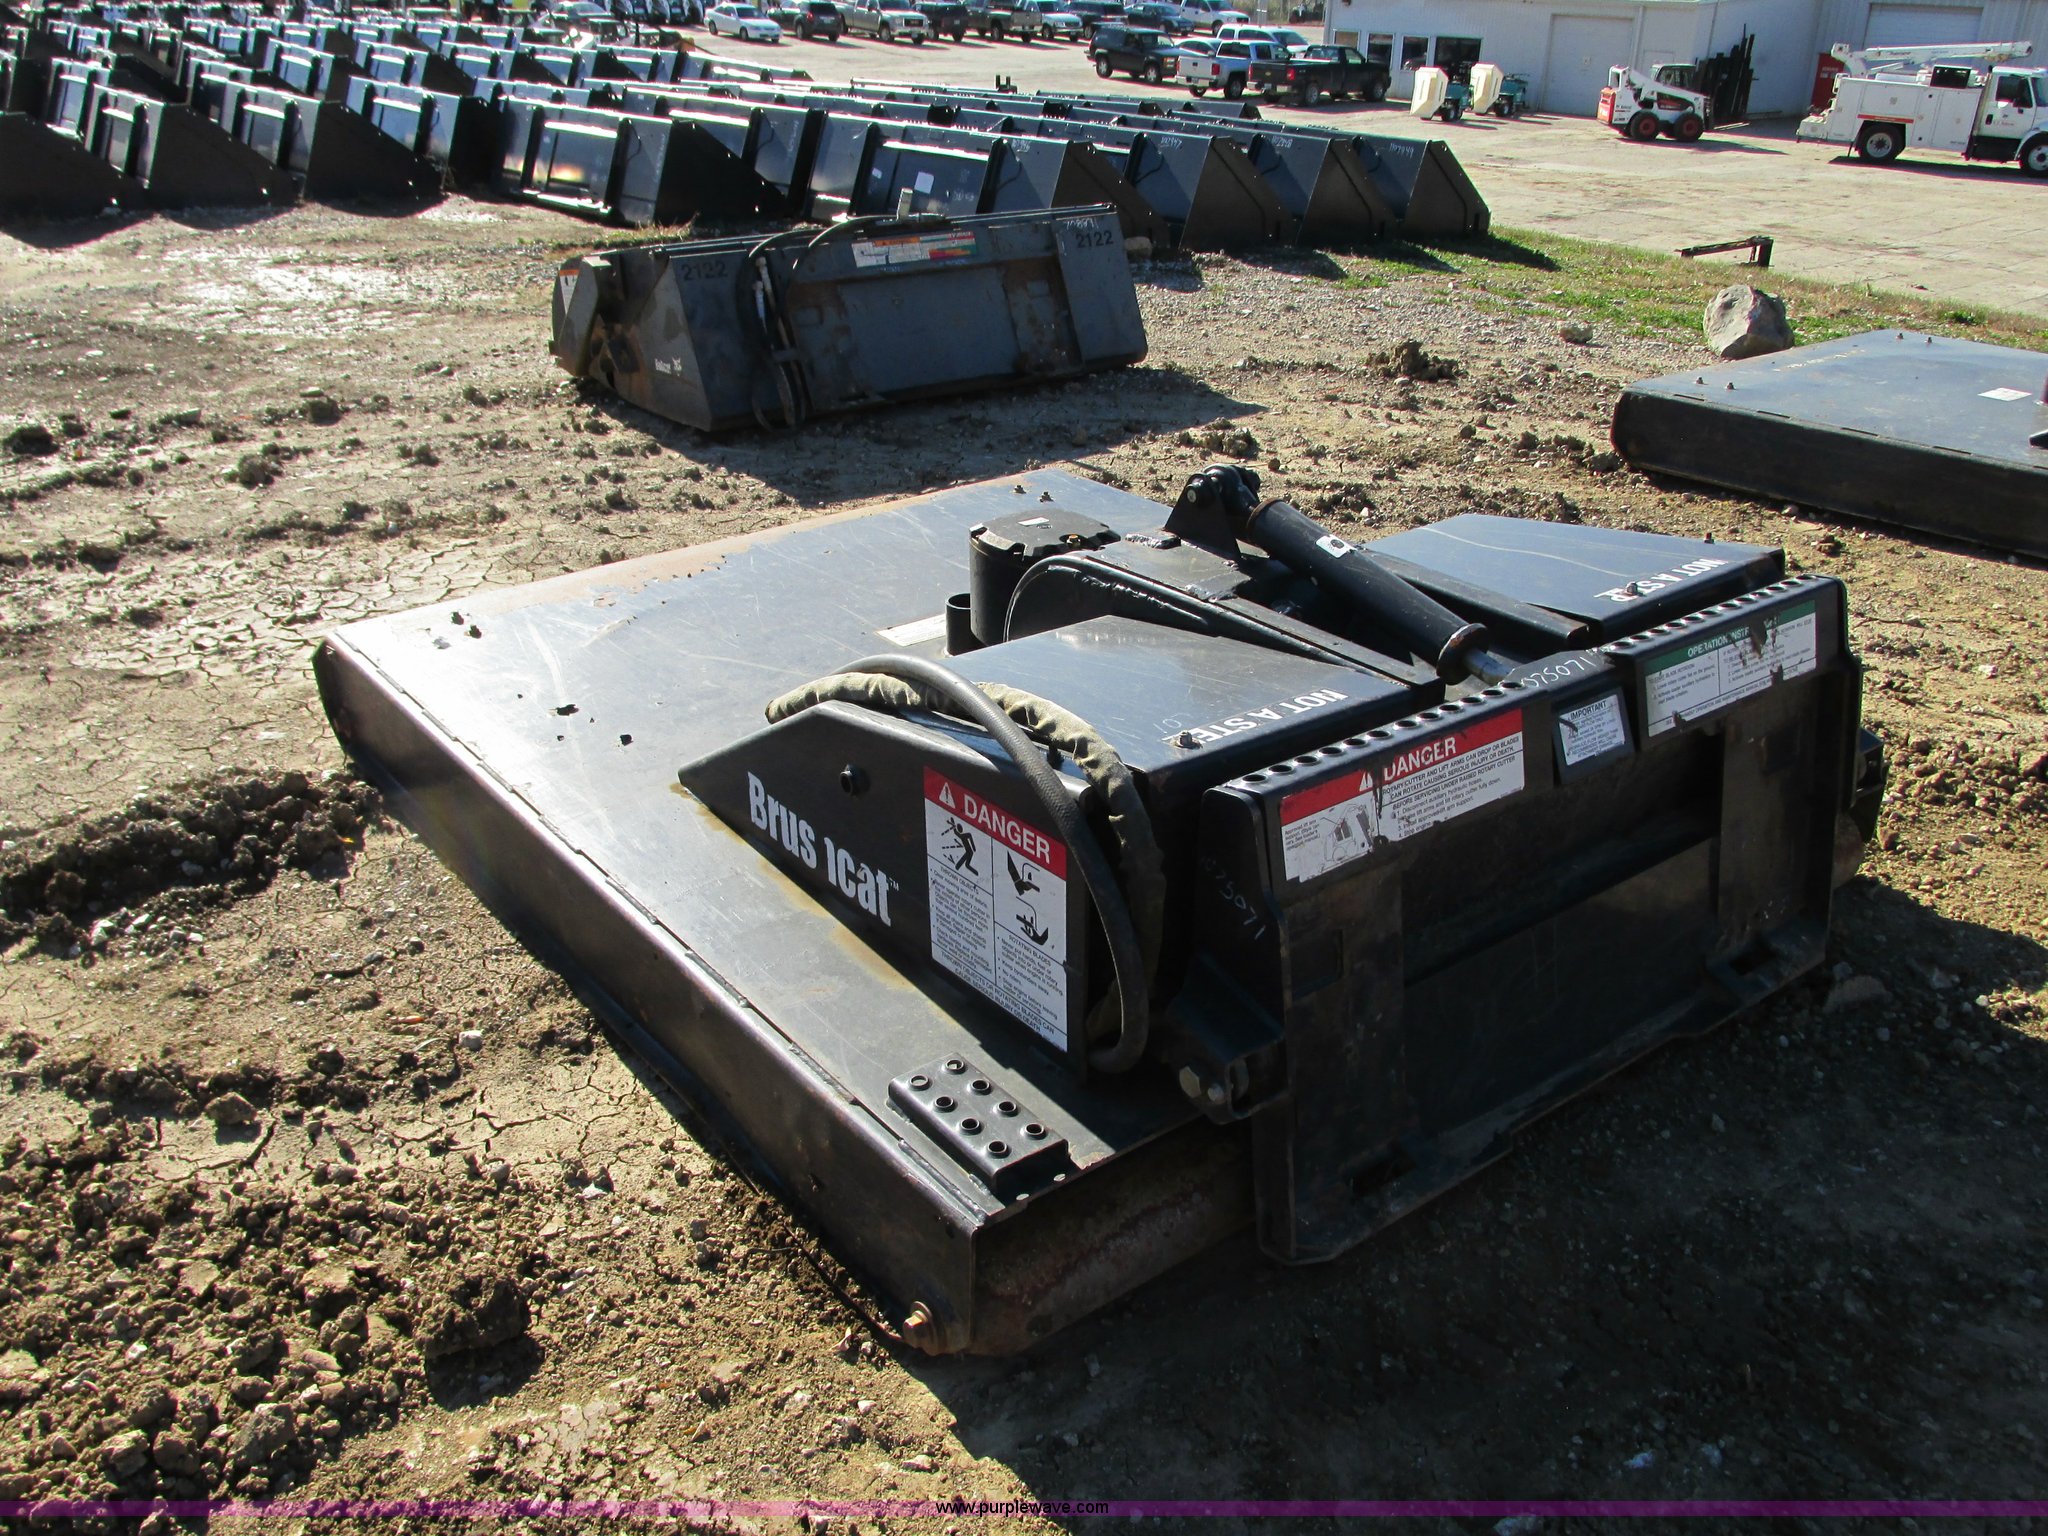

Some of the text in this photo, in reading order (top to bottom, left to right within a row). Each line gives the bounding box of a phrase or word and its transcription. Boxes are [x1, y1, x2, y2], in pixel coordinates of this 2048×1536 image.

[1075, 230, 1114, 248] 2122
[680, 261, 729, 281] 2122
[1671, 558, 1729, 577] NOT
[1650, 573, 1683, 583] A
[1687, 633, 1727, 657] OPERATION
[1161, 688, 1348, 744] NOT A STE
[1570, 700, 1607, 720] IMPORTANT
[1383, 738, 1457, 782] DANGER
[964, 793, 1052, 864] DANGER
